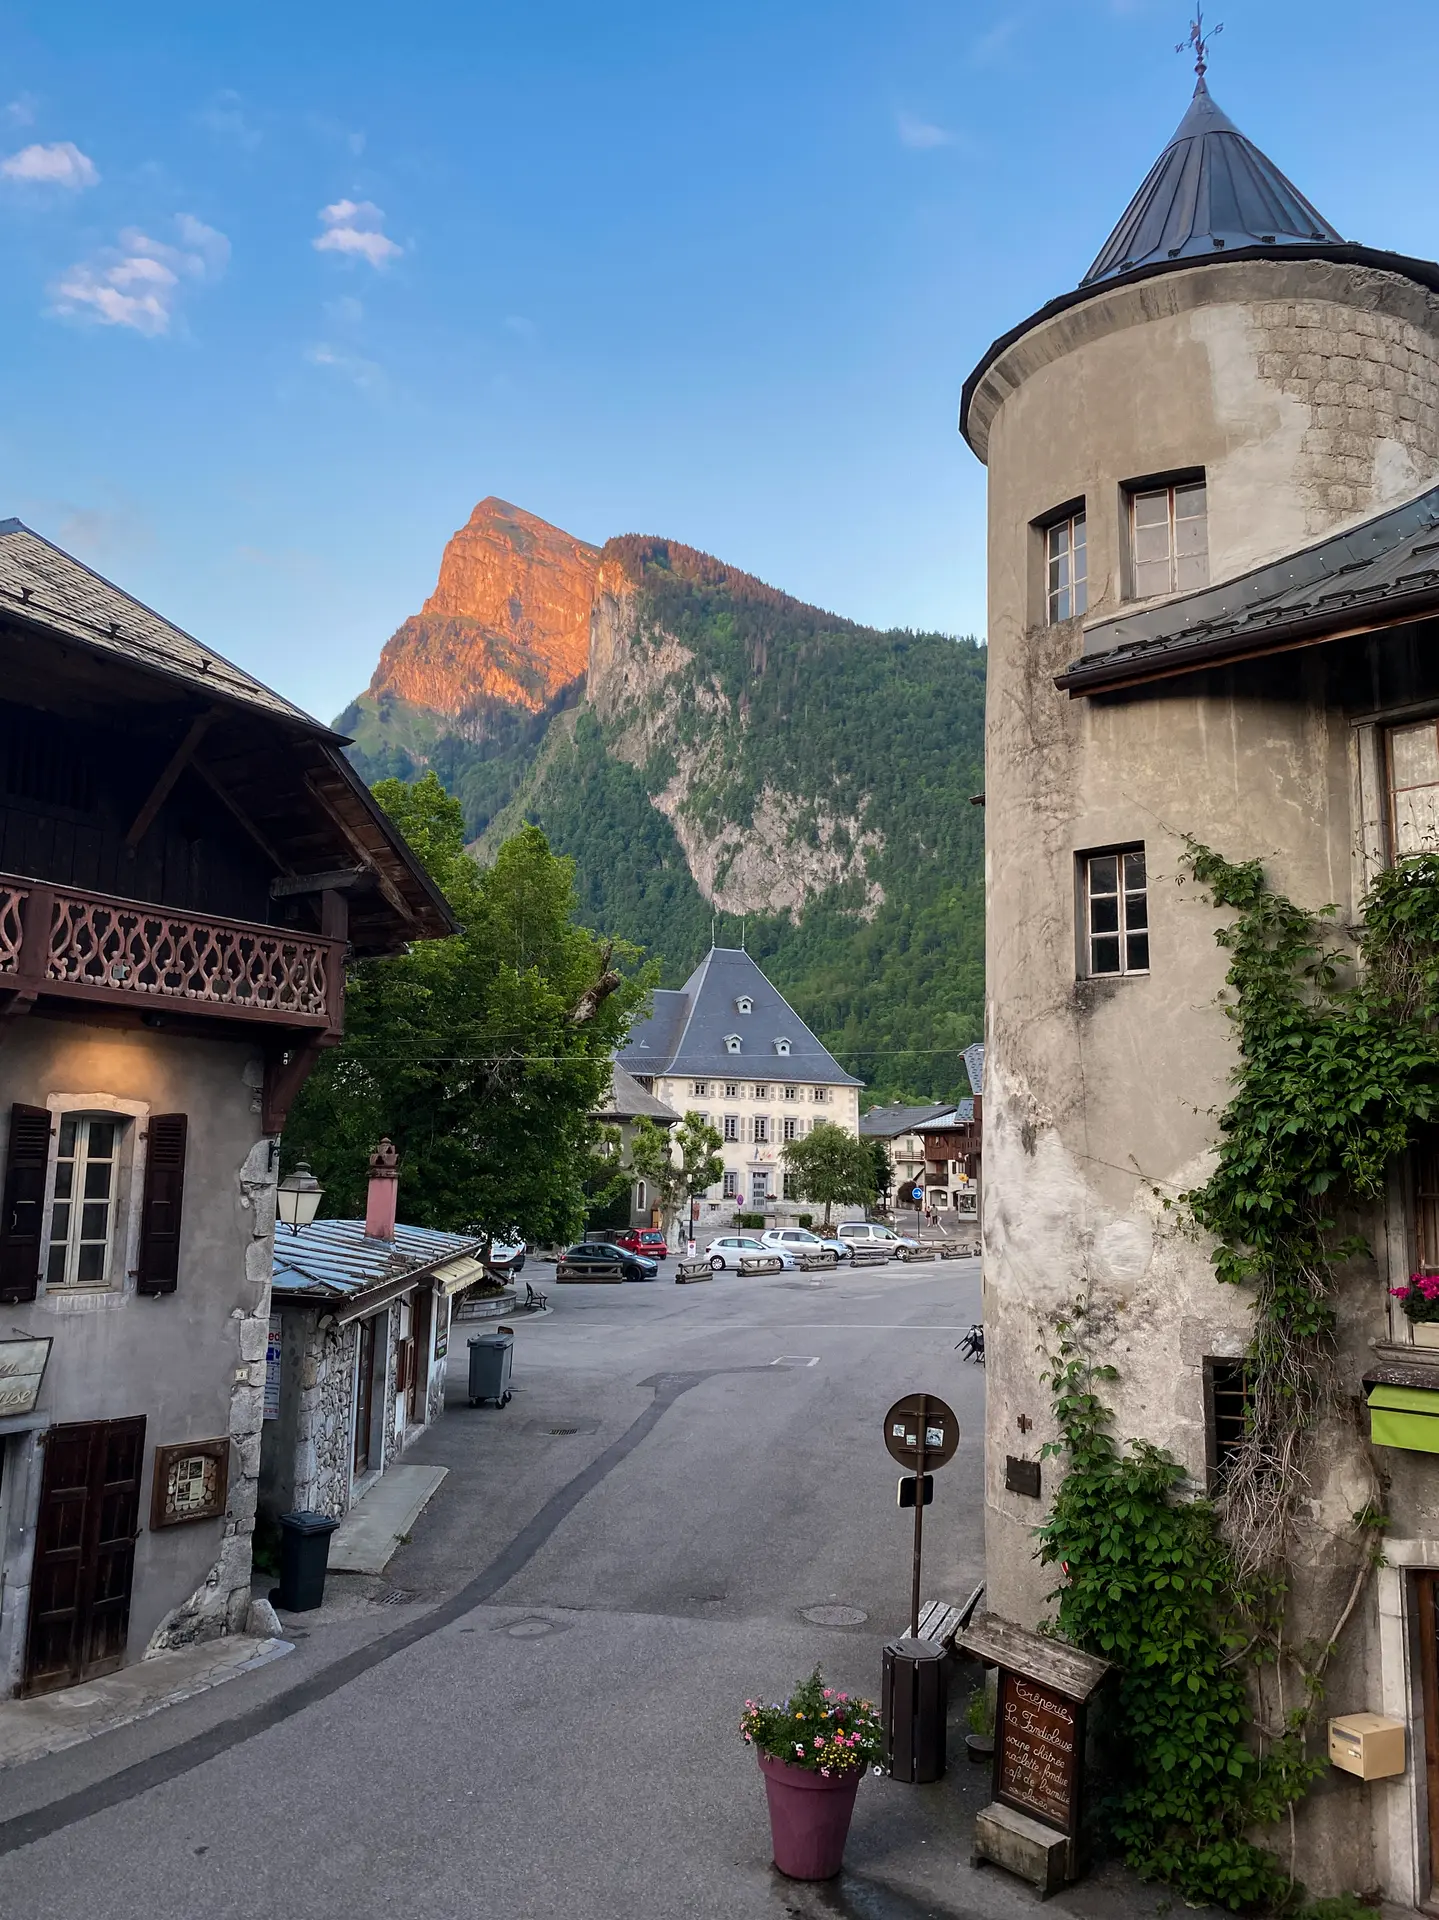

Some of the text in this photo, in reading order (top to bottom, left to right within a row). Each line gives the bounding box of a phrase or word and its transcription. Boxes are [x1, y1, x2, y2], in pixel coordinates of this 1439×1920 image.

[1013, 1677, 1068, 1718] Crêperie
[1005, 1702, 1073, 1751] La Fandioleuse
[1005, 1735, 1065, 1769] soupe châtrée
[1004, 1765, 1070, 1805] café de l'amitié
[1040, 1763, 1069, 1787] fondue
